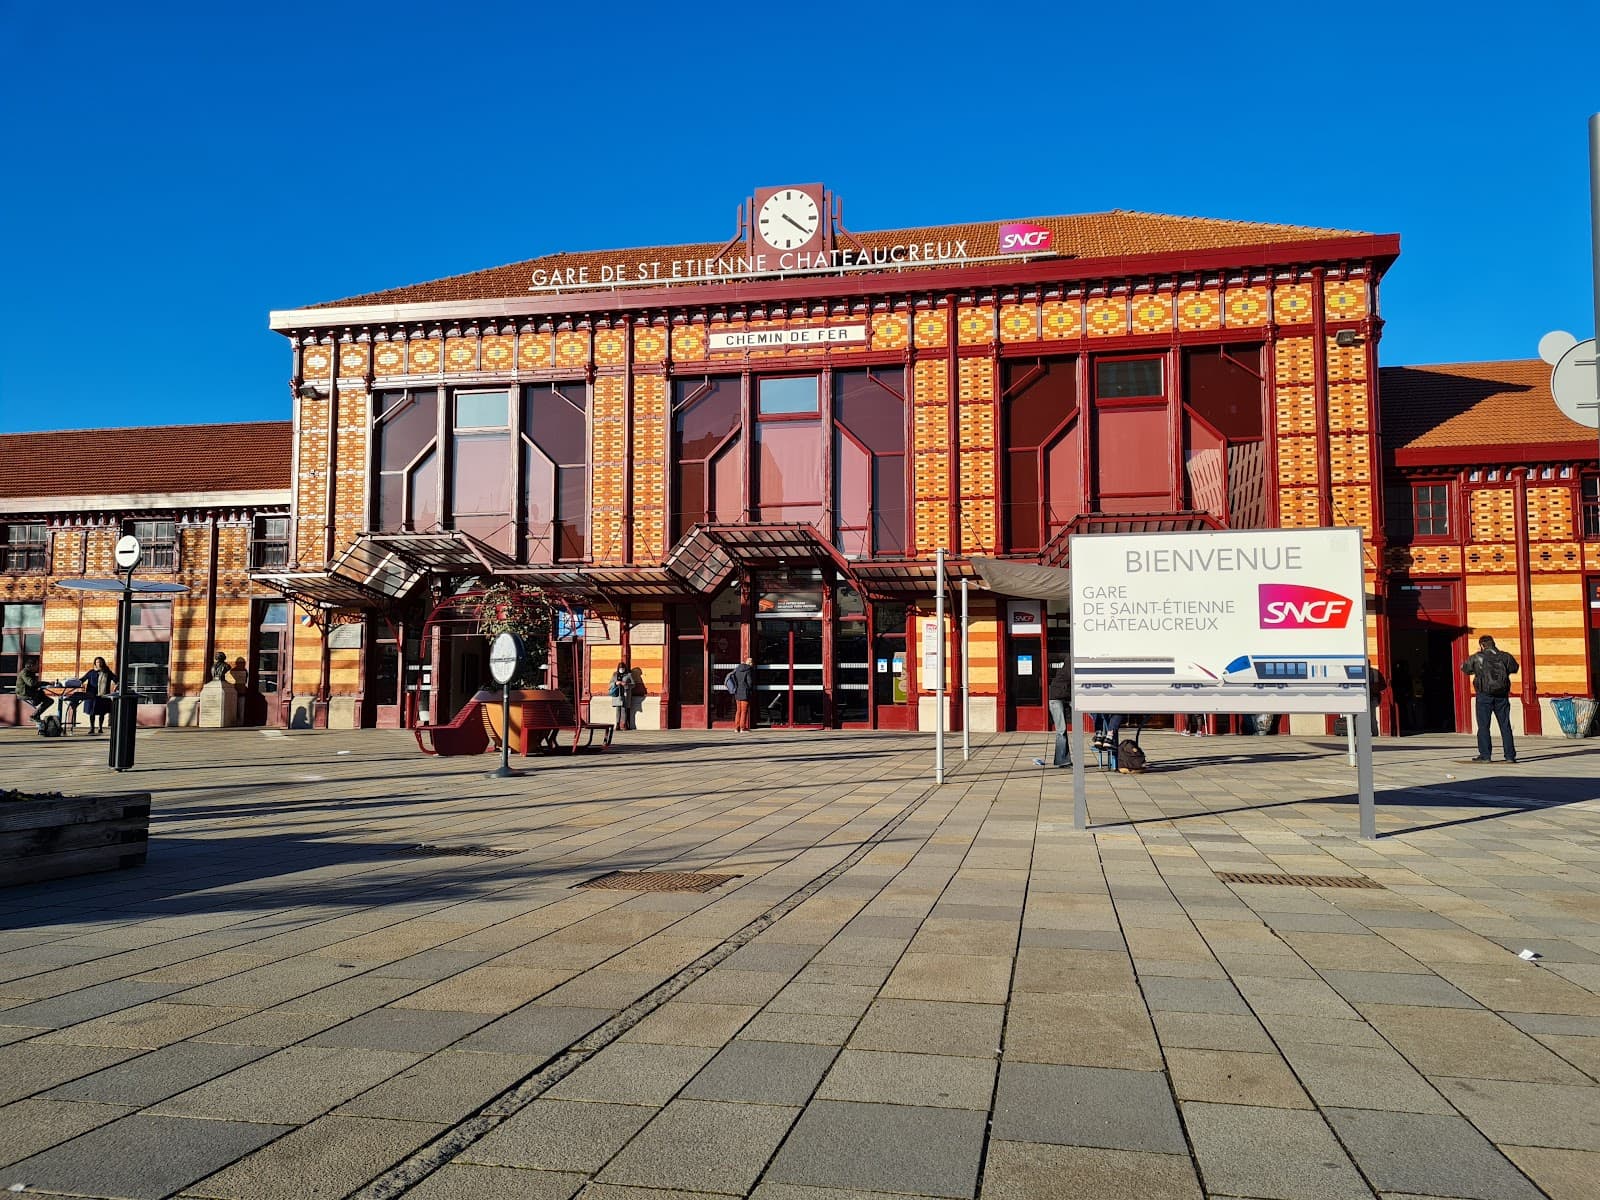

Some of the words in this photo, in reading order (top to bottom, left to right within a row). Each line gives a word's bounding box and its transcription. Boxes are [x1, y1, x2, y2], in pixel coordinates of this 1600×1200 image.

[1004, 230, 1050, 249] SNCF
[531, 266, 589, 286] GARE
[601, 264, 627, 282] DE
[637, 262, 660, 280] ST
[672, 254, 767, 277] ETIENNE
[779, 239, 968, 270] CHATEAUCREUX
[726, 331, 783, 346] CHEMIN
[791, 330, 811, 344] DE
[818, 328, 849, 342] FER
[1126, 546, 1303, 574] BIENVENUE
[1082, 585, 1128, 600] GARE
[1083, 602, 1105, 616] DE
[1110, 598, 1235, 615] SAINT-ÉTIENNE
[1263, 600, 1346, 624] SNCF
[1083, 616, 1219, 632] CHÂTEAUCREUX
